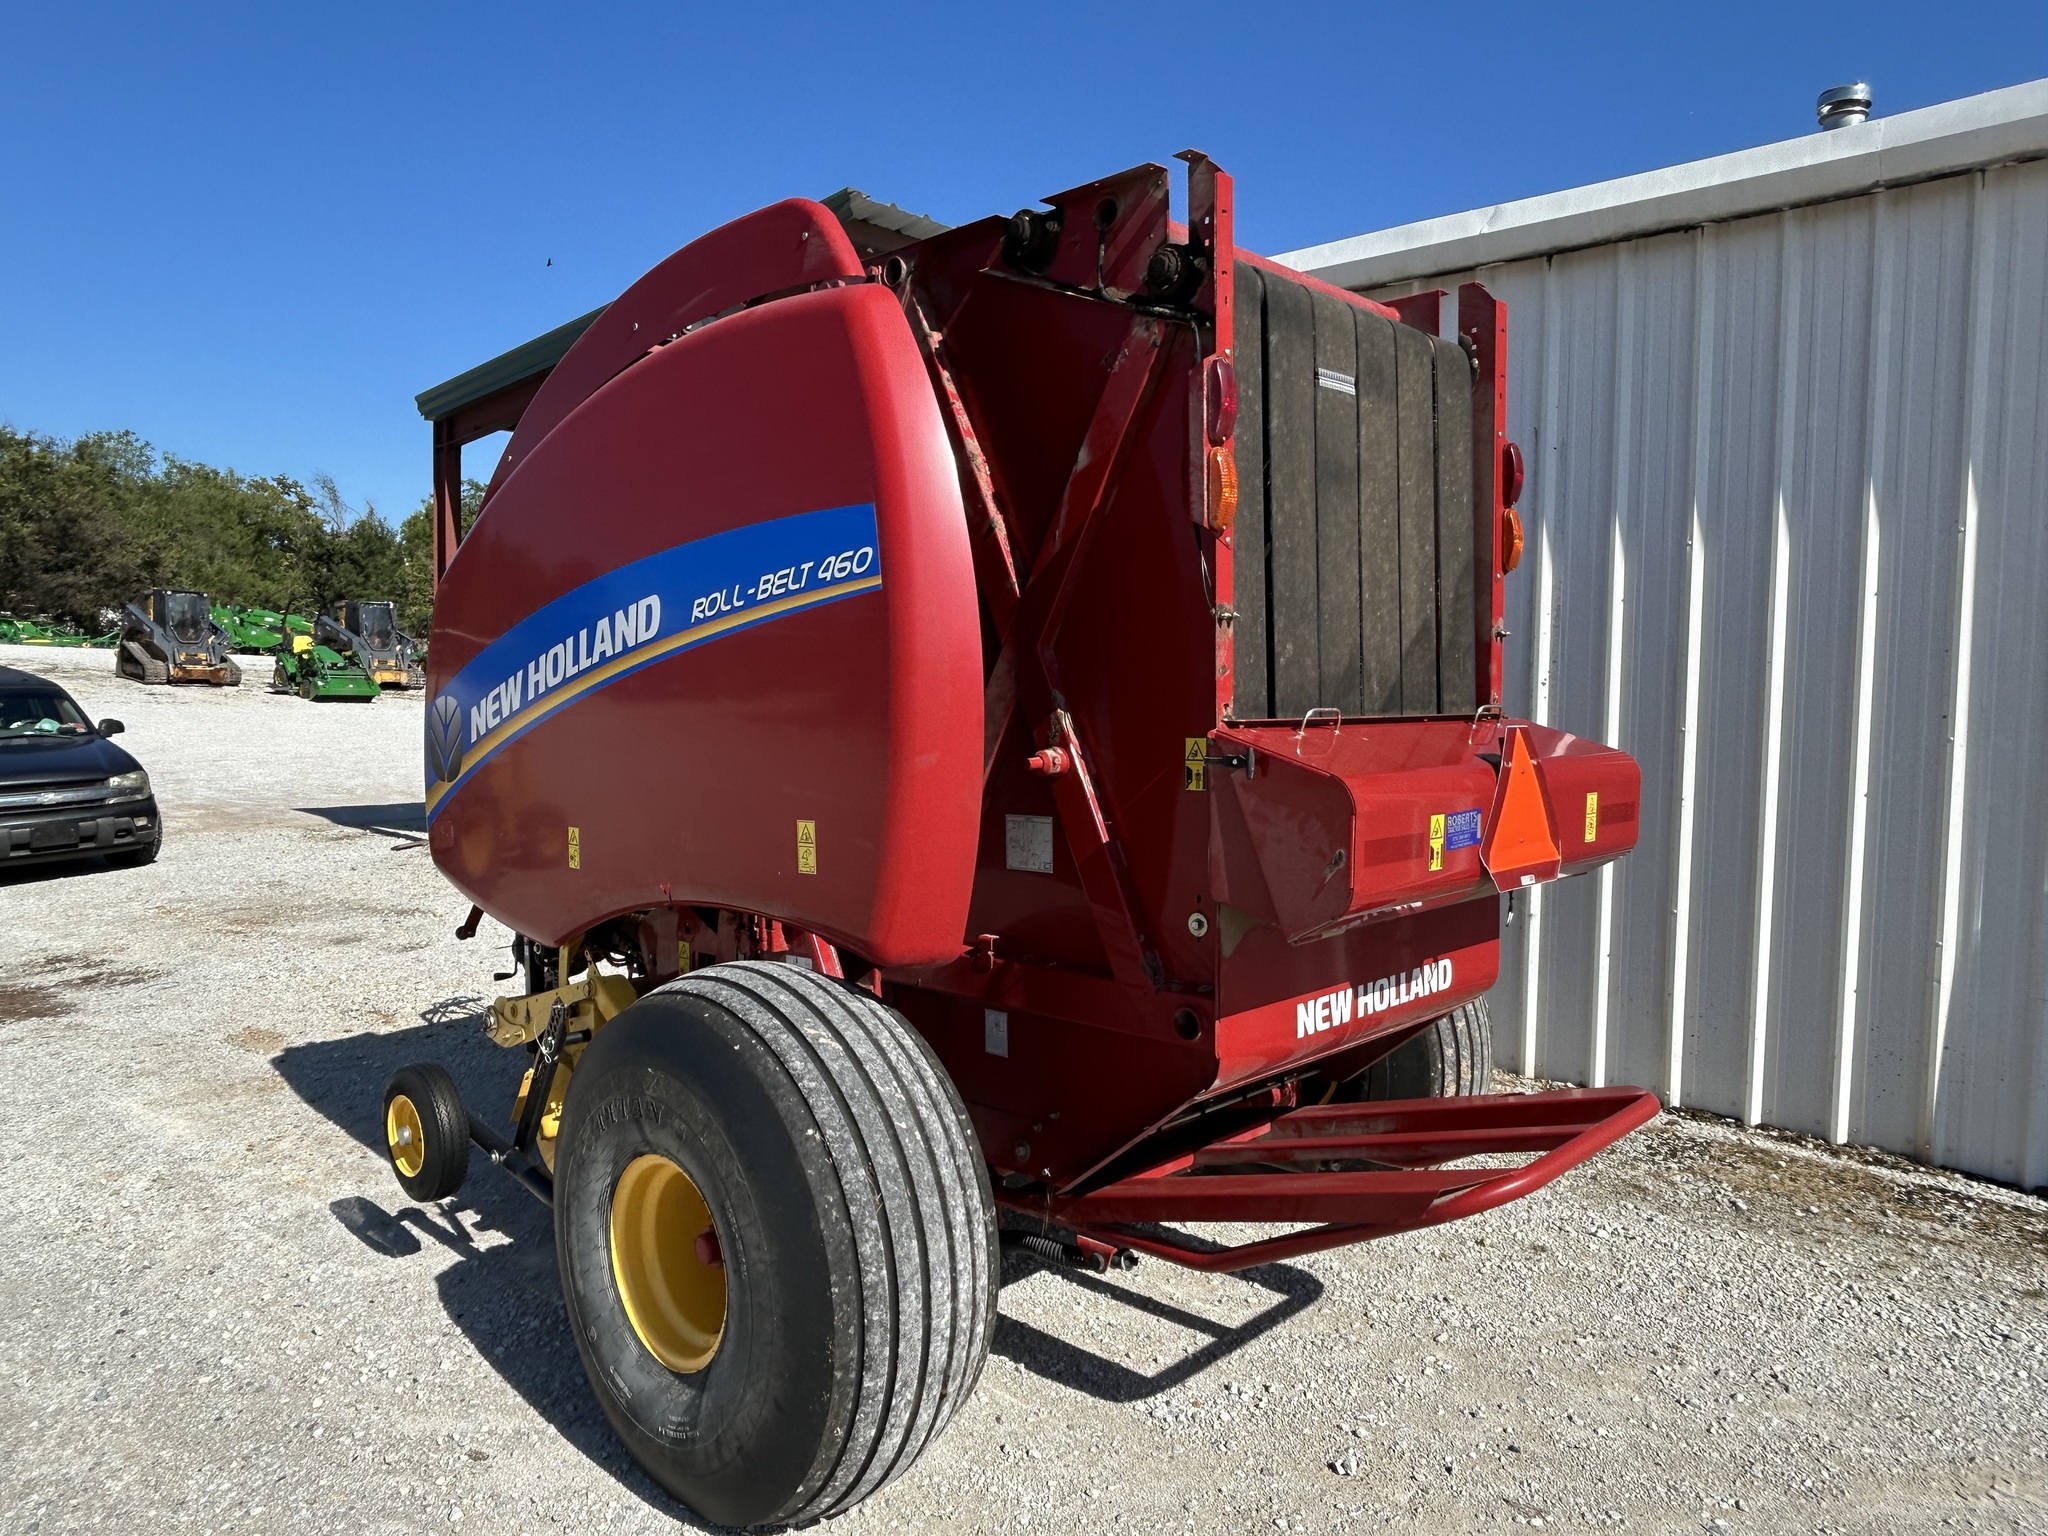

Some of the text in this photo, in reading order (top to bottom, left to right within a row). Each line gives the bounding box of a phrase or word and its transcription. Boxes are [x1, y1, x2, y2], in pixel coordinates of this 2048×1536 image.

[691, 546, 873, 623] ROLL-BELT 460
[471, 594, 661, 744] NEW HOLLAND
[1447, 811, 1478, 826] ROBERTS
[1297, 958, 1453, 1039] NEW HOLLAND
